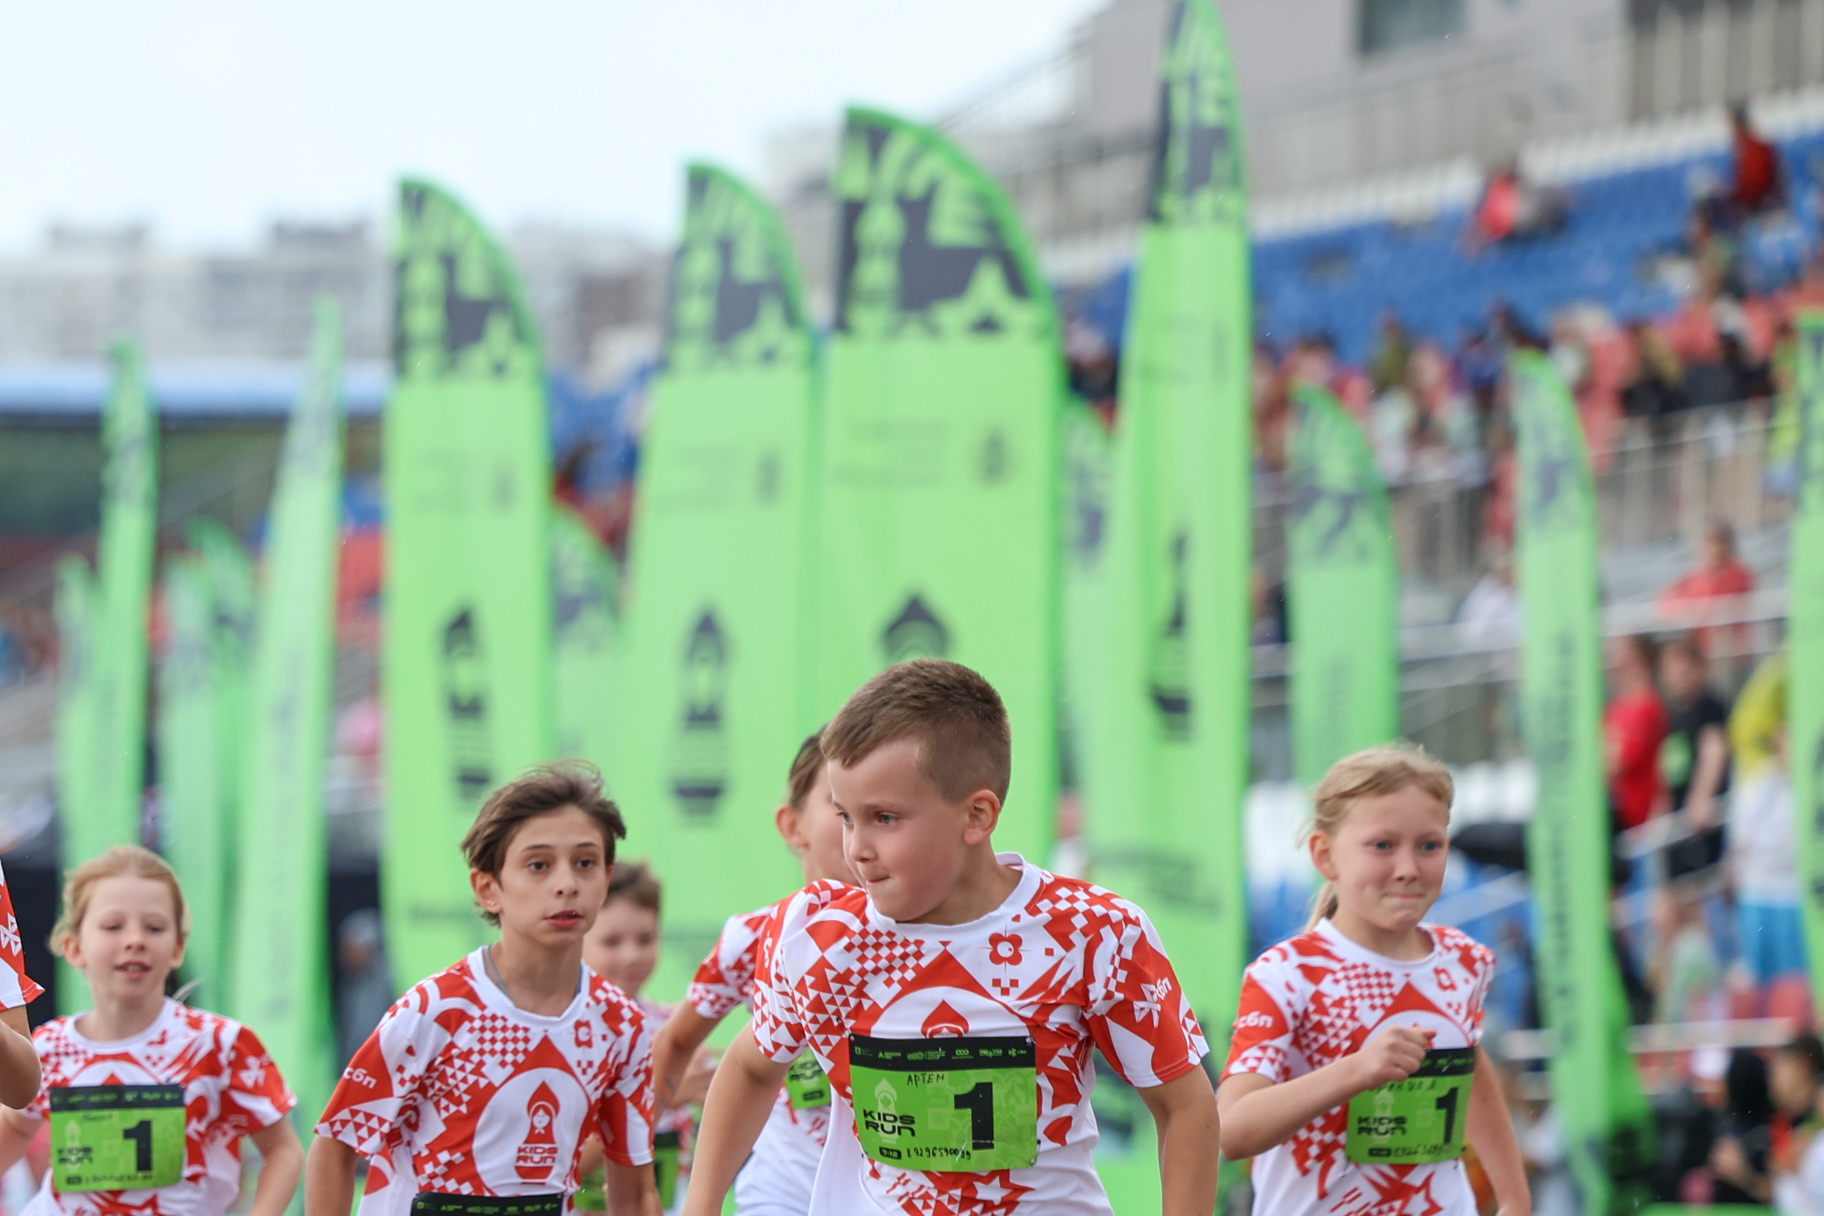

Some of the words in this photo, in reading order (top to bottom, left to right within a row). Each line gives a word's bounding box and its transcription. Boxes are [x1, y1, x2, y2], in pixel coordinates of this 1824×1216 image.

[1238, 1010, 1274, 1029] сбп
[343, 1066, 377, 1089] сбп
[863, 1109, 916, 1125] KIDS
[954, 1082, 995, 1150] 1
[1436, 1087, 1459, 1144] 1
[123, 1120, 152, 1171] 1
[517, 1146, 558, 1155] KIDS
